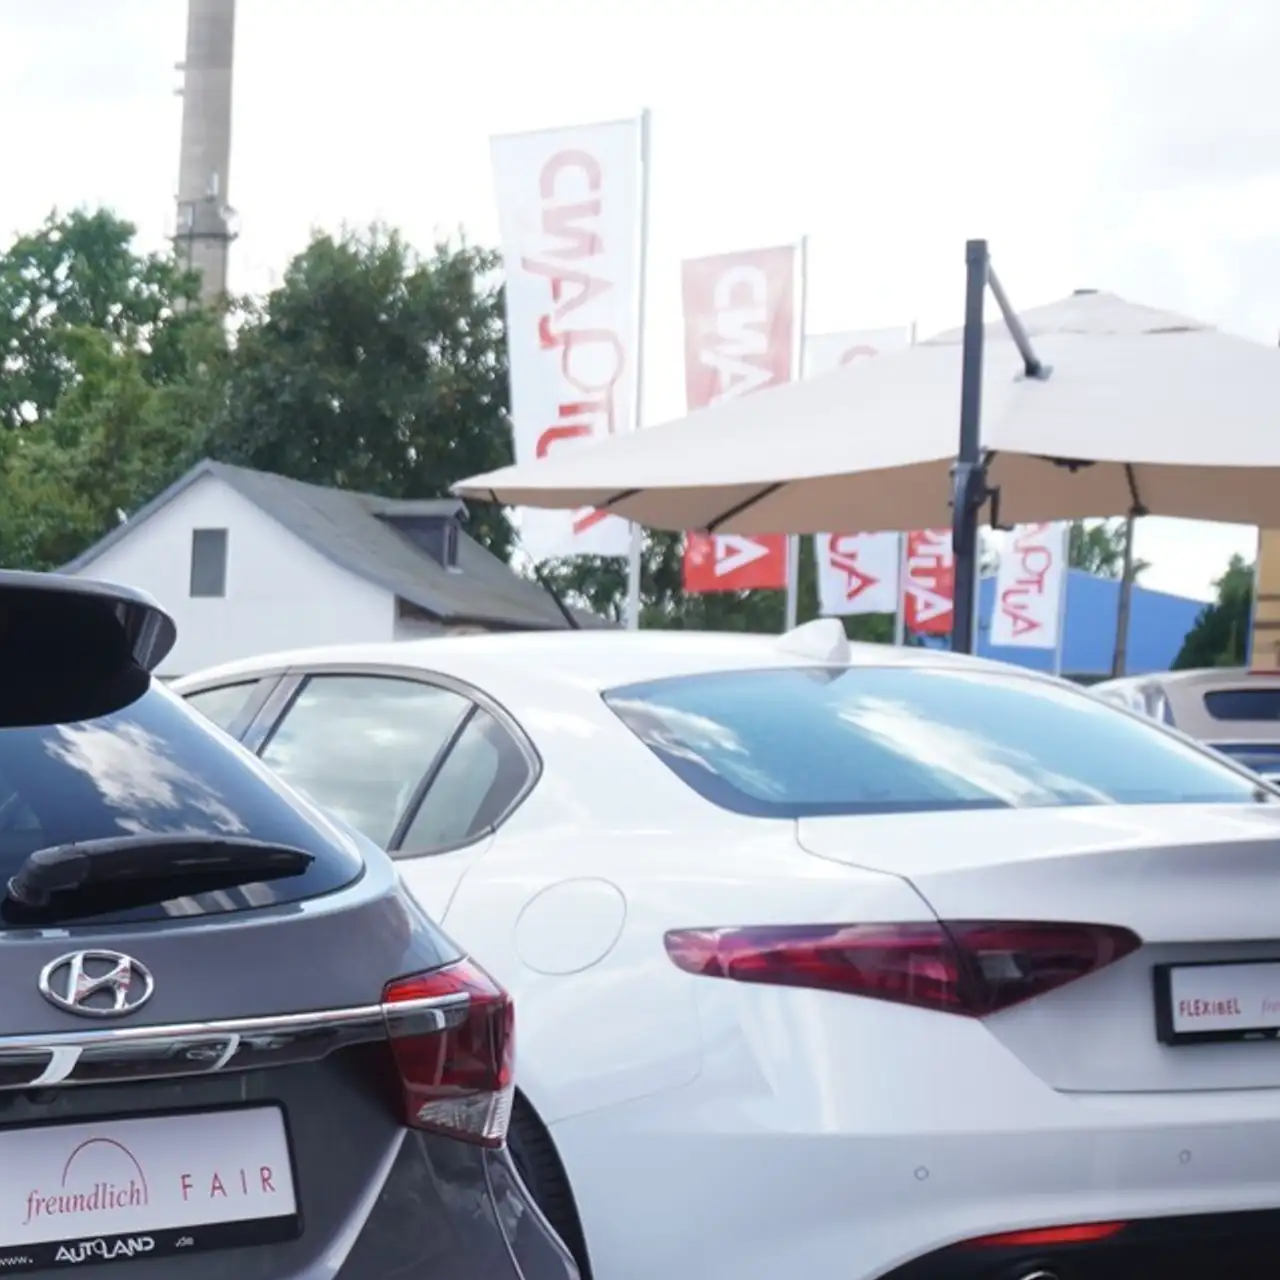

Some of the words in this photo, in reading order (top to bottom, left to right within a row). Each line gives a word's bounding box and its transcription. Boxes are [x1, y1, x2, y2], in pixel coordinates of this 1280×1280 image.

[1179, 997, 1242, 1018] FLEXIBEL
[23, 1180, 142, 1226] freundlich
[181, 1166, 276, 1201] FAIR
[55, 1236, 155, 1264] AUTOLAND
